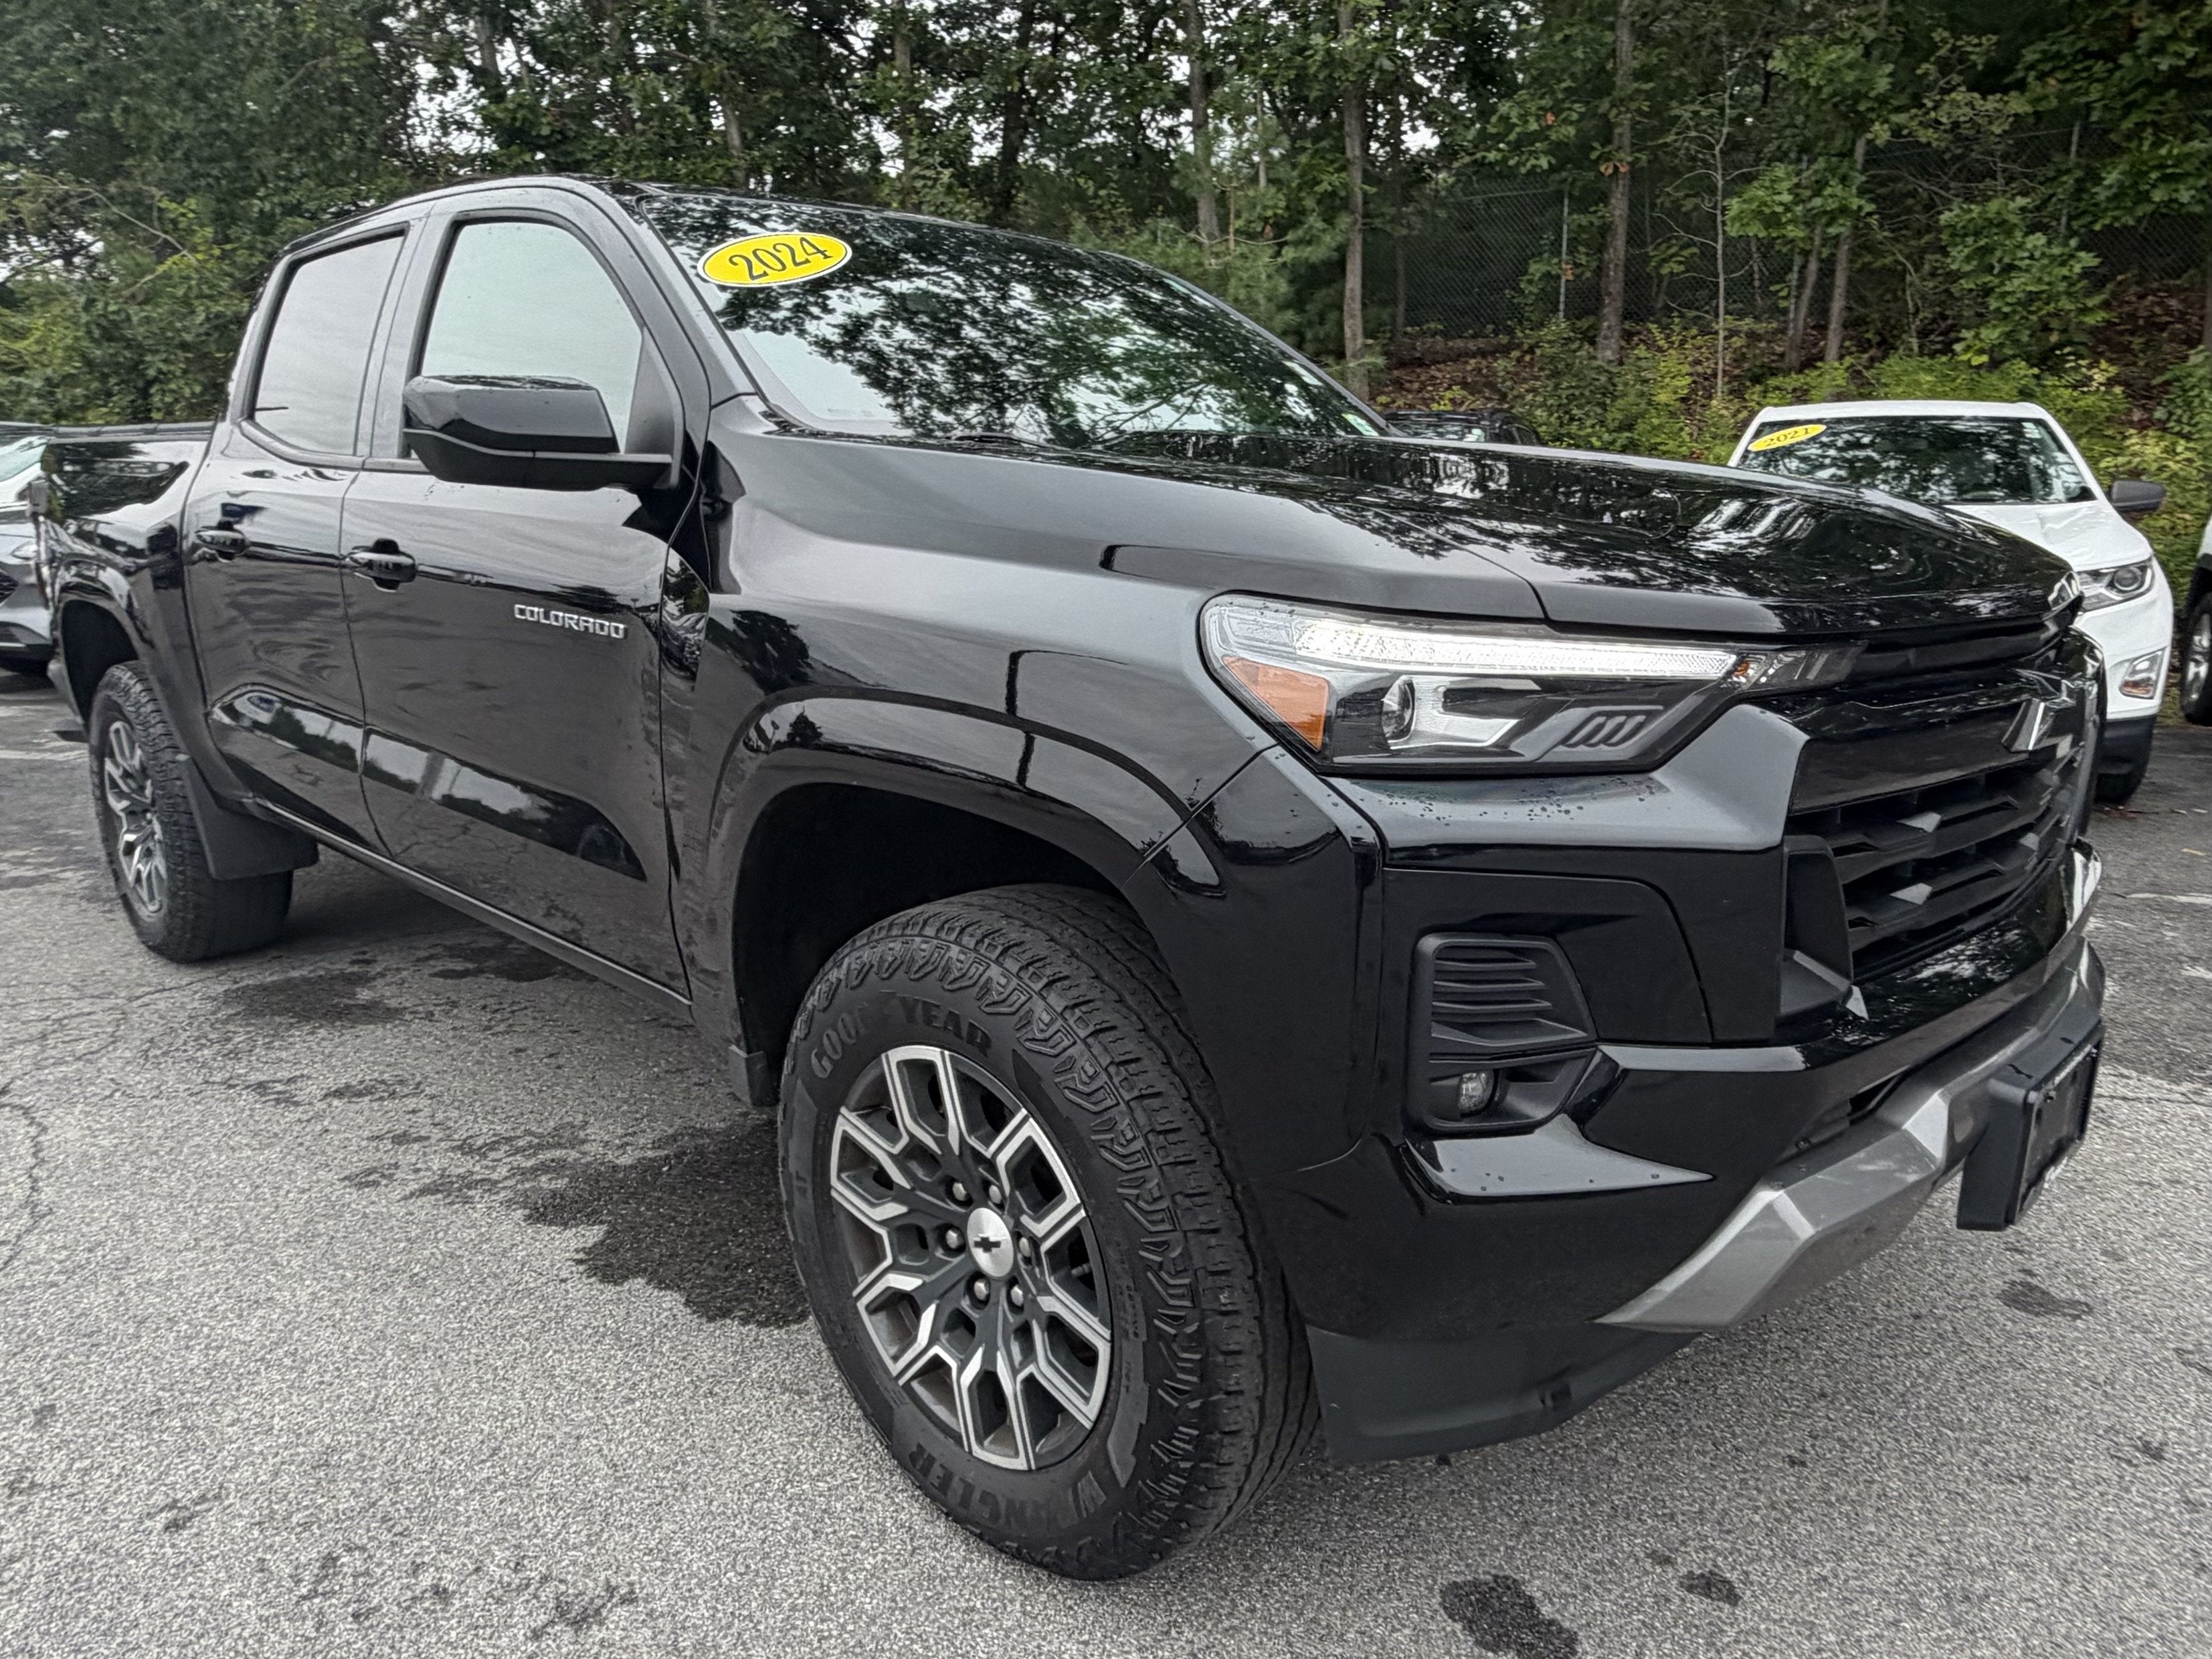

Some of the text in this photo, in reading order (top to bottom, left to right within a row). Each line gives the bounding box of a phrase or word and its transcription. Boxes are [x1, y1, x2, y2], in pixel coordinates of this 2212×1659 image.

[728, 237, 834, 281] 2024
[1763, 427, 1810, 447] 2021
[513, 603, 627, 640] COLORADO
